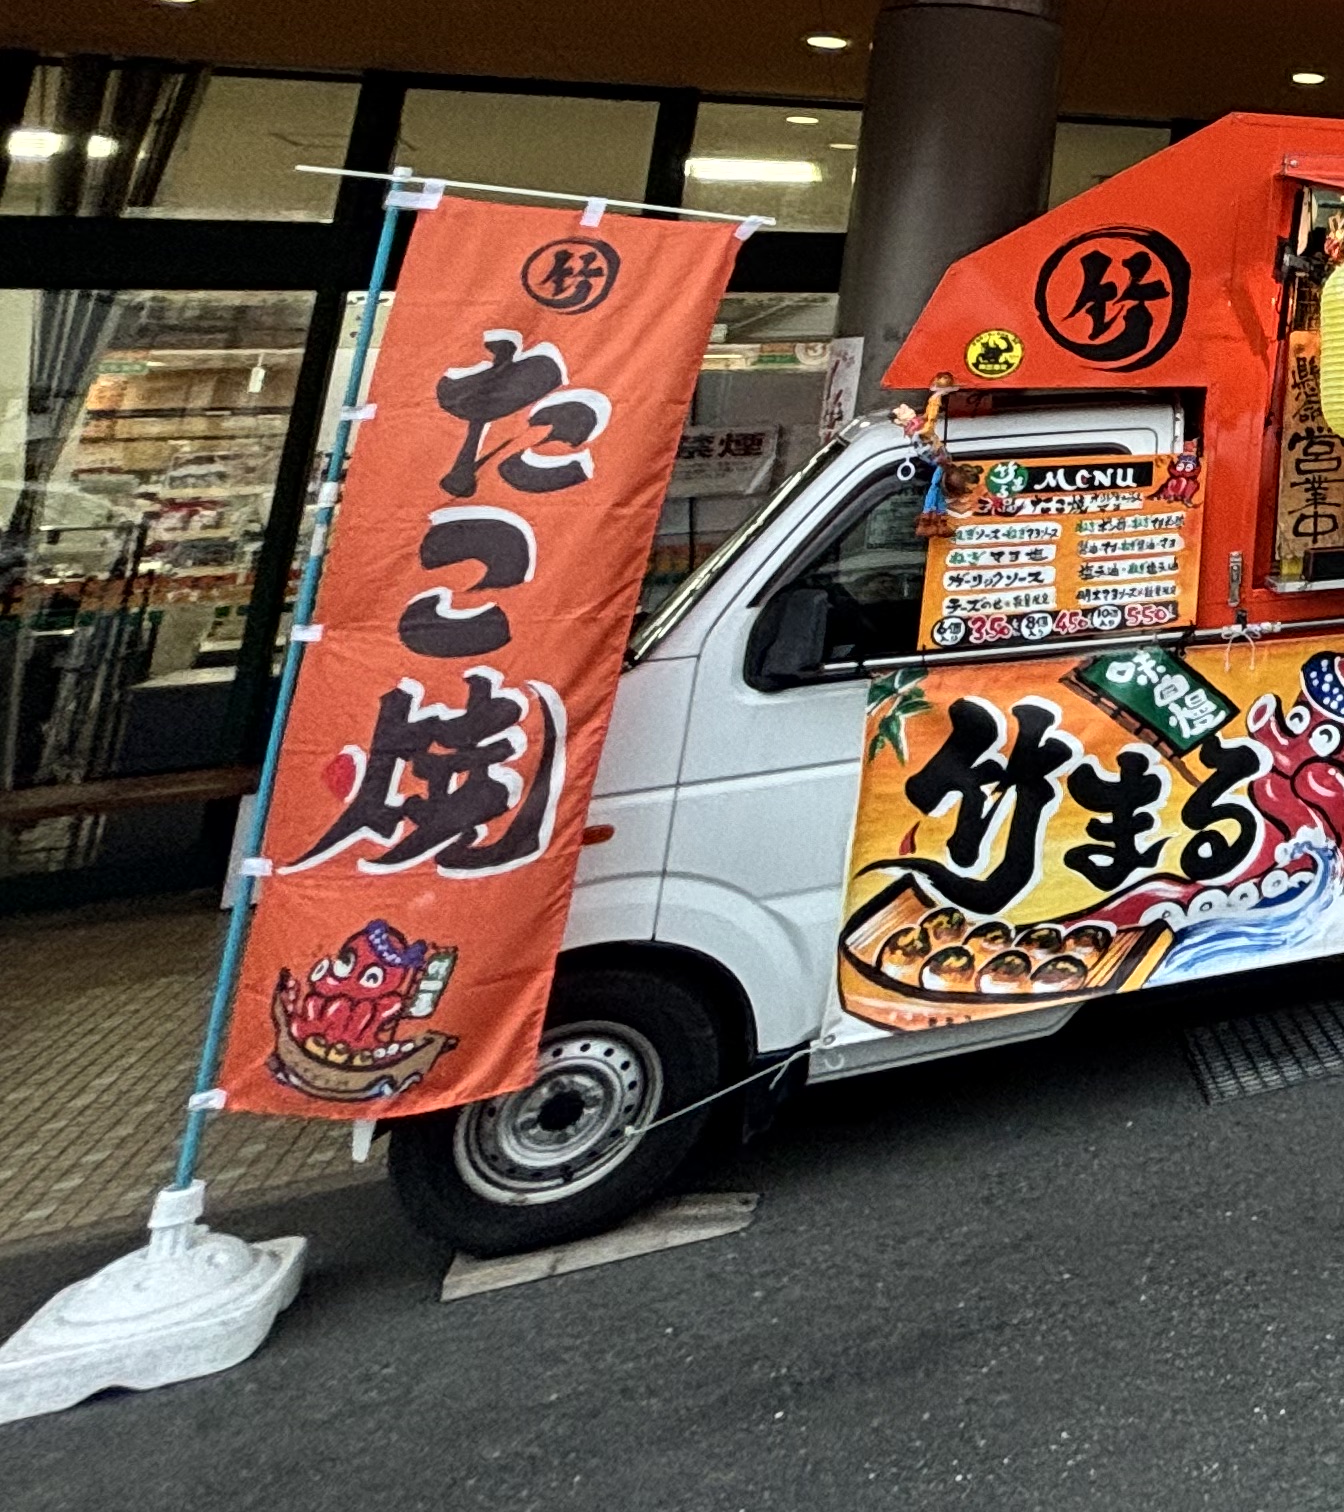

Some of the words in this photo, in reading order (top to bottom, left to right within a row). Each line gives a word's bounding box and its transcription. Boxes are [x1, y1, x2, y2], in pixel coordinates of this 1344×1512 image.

[531, 243, 612, 308] 竹
[1050, 238, 1180, 363] 竹
[276, 330, 612, 878] たこ焼
[947, 571, 1045, 588] ガーリックソース
[969, 615, 1013, 642] 350
[1053, 611, 1089, 634] 450
[1124, 604, 1170, 627] 550
[1106, 649, 1226, 739] 味自慢
[874, 694, 1274, 915] 竹まる
